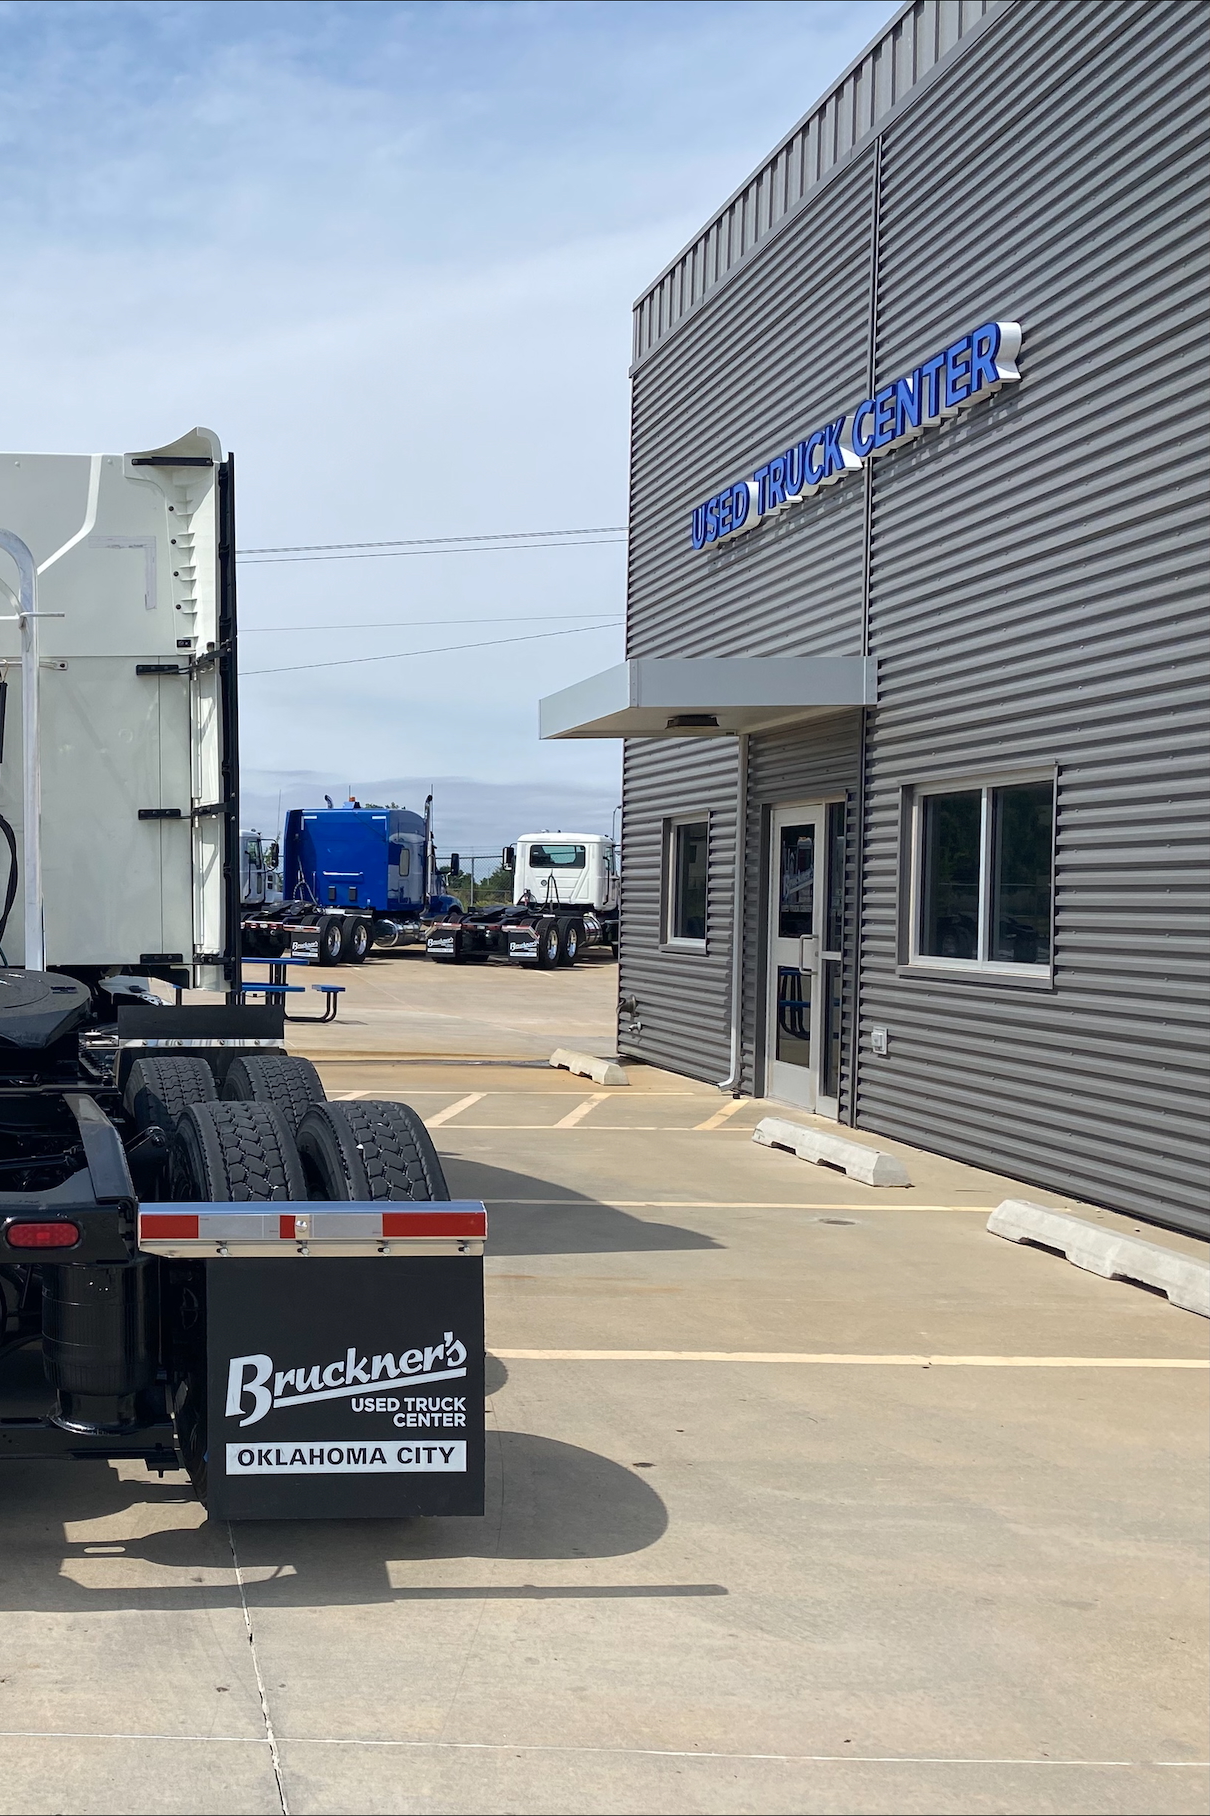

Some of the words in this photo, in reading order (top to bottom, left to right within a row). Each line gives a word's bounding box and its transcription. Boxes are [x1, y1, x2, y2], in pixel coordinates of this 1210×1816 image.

[691, 481, 759, 551] USED
[753, 415, 863, 516] TRUCK
[851, 321, 1022, 458] CENTER
[225, 1331, 467, 1428] Bruckner's
[351, 1398, 400, 1412] USED
[403, 1397, 467, 1412] TRUCK
[393, 1413, 467, 1427] CENTER
[237, 1448, 387, 1467] OKLAHOMA
[396, 1447, 455, 1464] CITY
